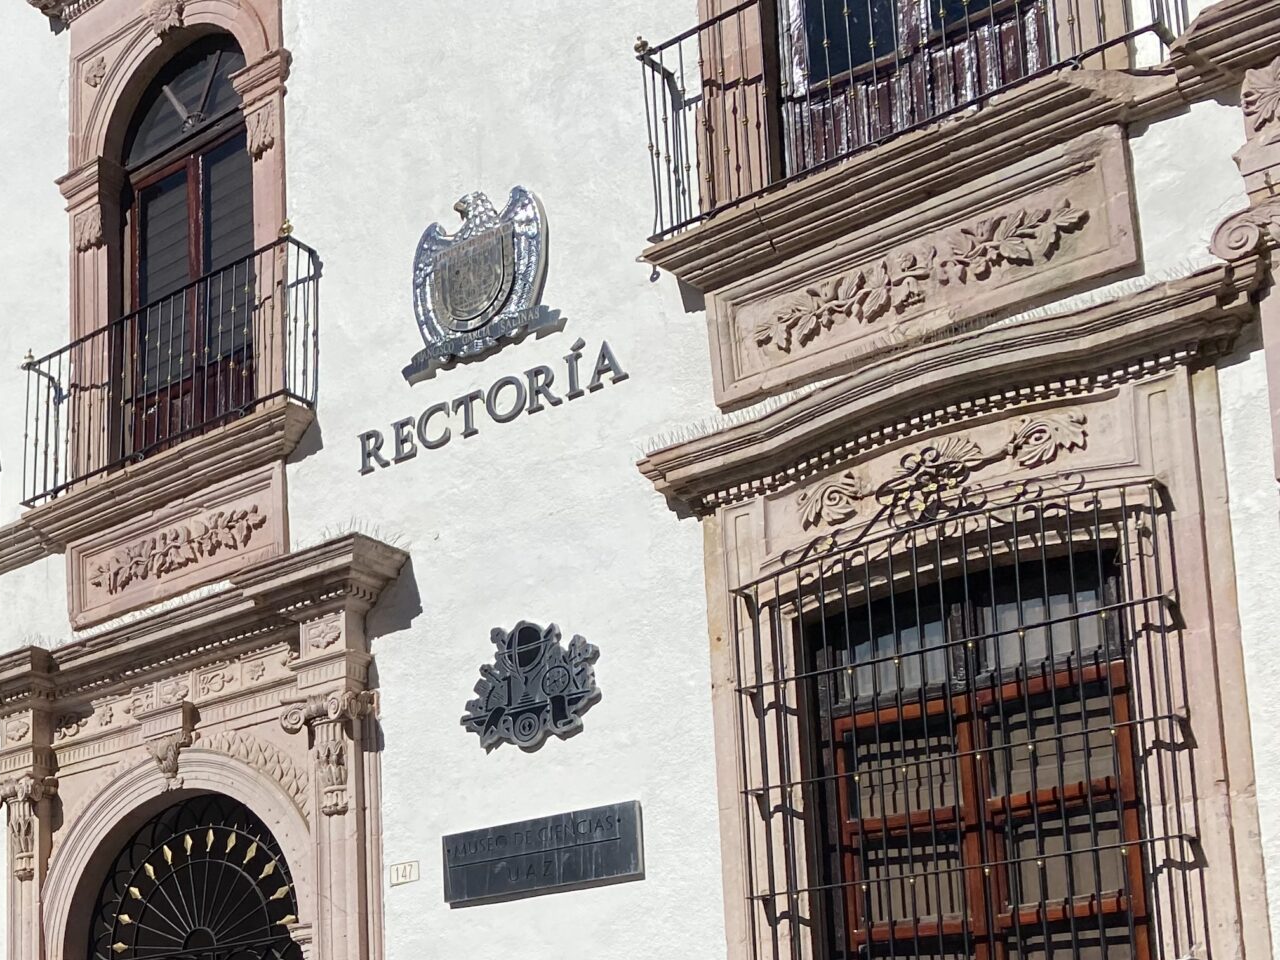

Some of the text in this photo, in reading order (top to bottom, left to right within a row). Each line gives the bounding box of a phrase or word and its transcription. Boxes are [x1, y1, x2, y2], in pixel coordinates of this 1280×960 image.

[500, 307, 540, 333] SALINAS
[357, 337, 629, 476] RECTORÍA
[454, 815, 614, 858] MUSEO DE CIENCIAS
[395, 863, 413, 881] 147
